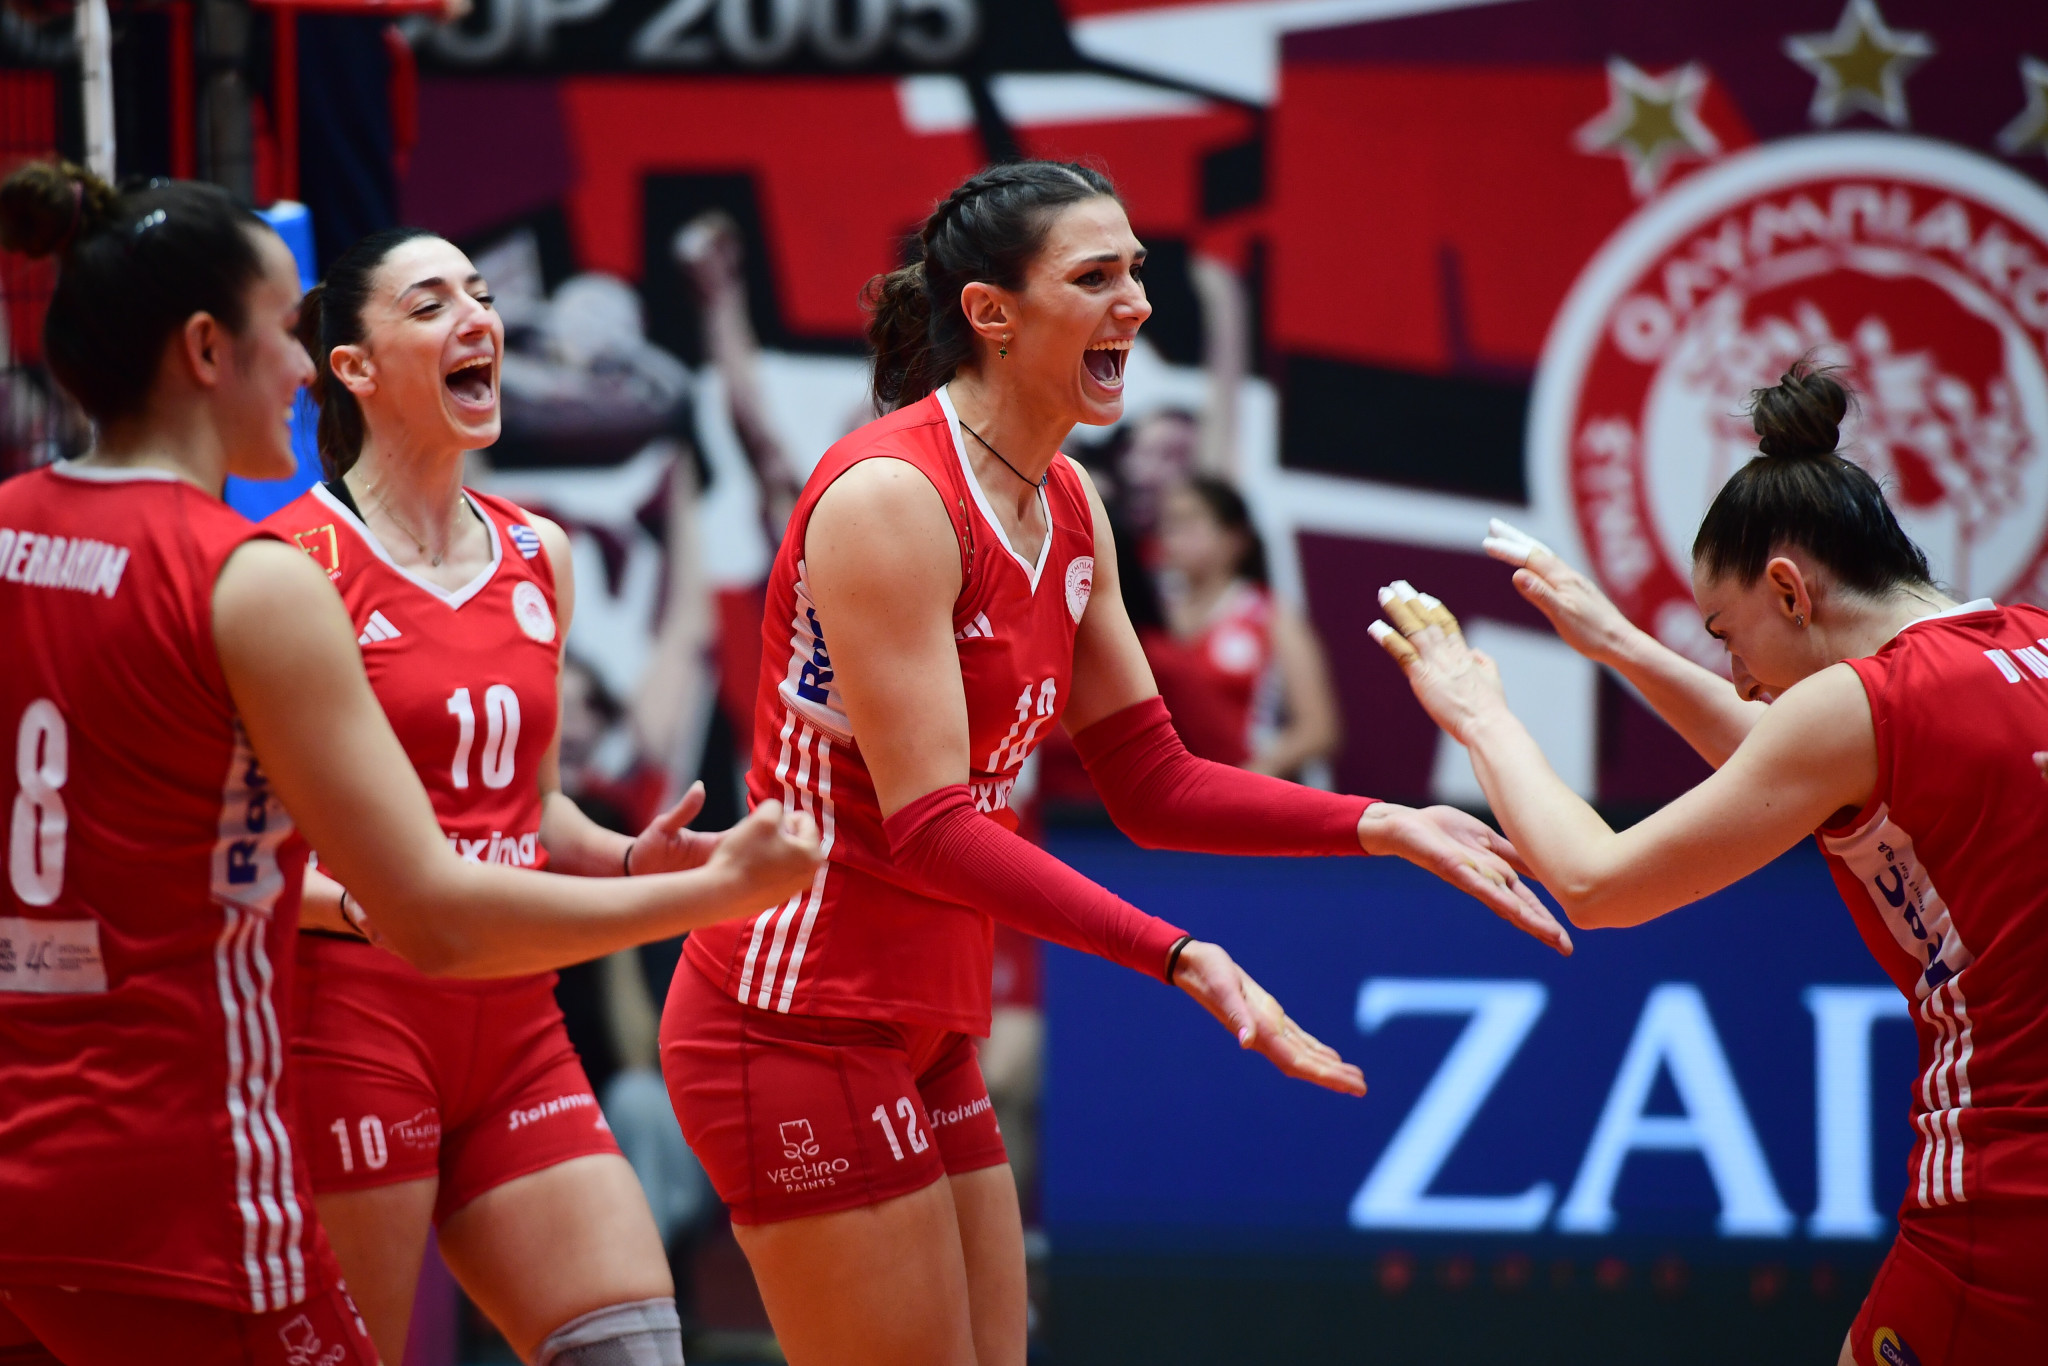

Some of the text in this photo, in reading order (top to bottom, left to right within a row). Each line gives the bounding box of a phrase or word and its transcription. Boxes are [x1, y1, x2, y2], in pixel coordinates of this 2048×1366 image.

[408, 0, 980, 63] UP 2005
[446, 684, 521, 789] 10
[9, 699, 68, 905] 8
[330, 1114, 388, 1173] 10
[871, 1096, 929, 1161] 12
[767, 1158, 849, 1184] VECHRO
[786, 1177, 836, 1194] PAINTS
